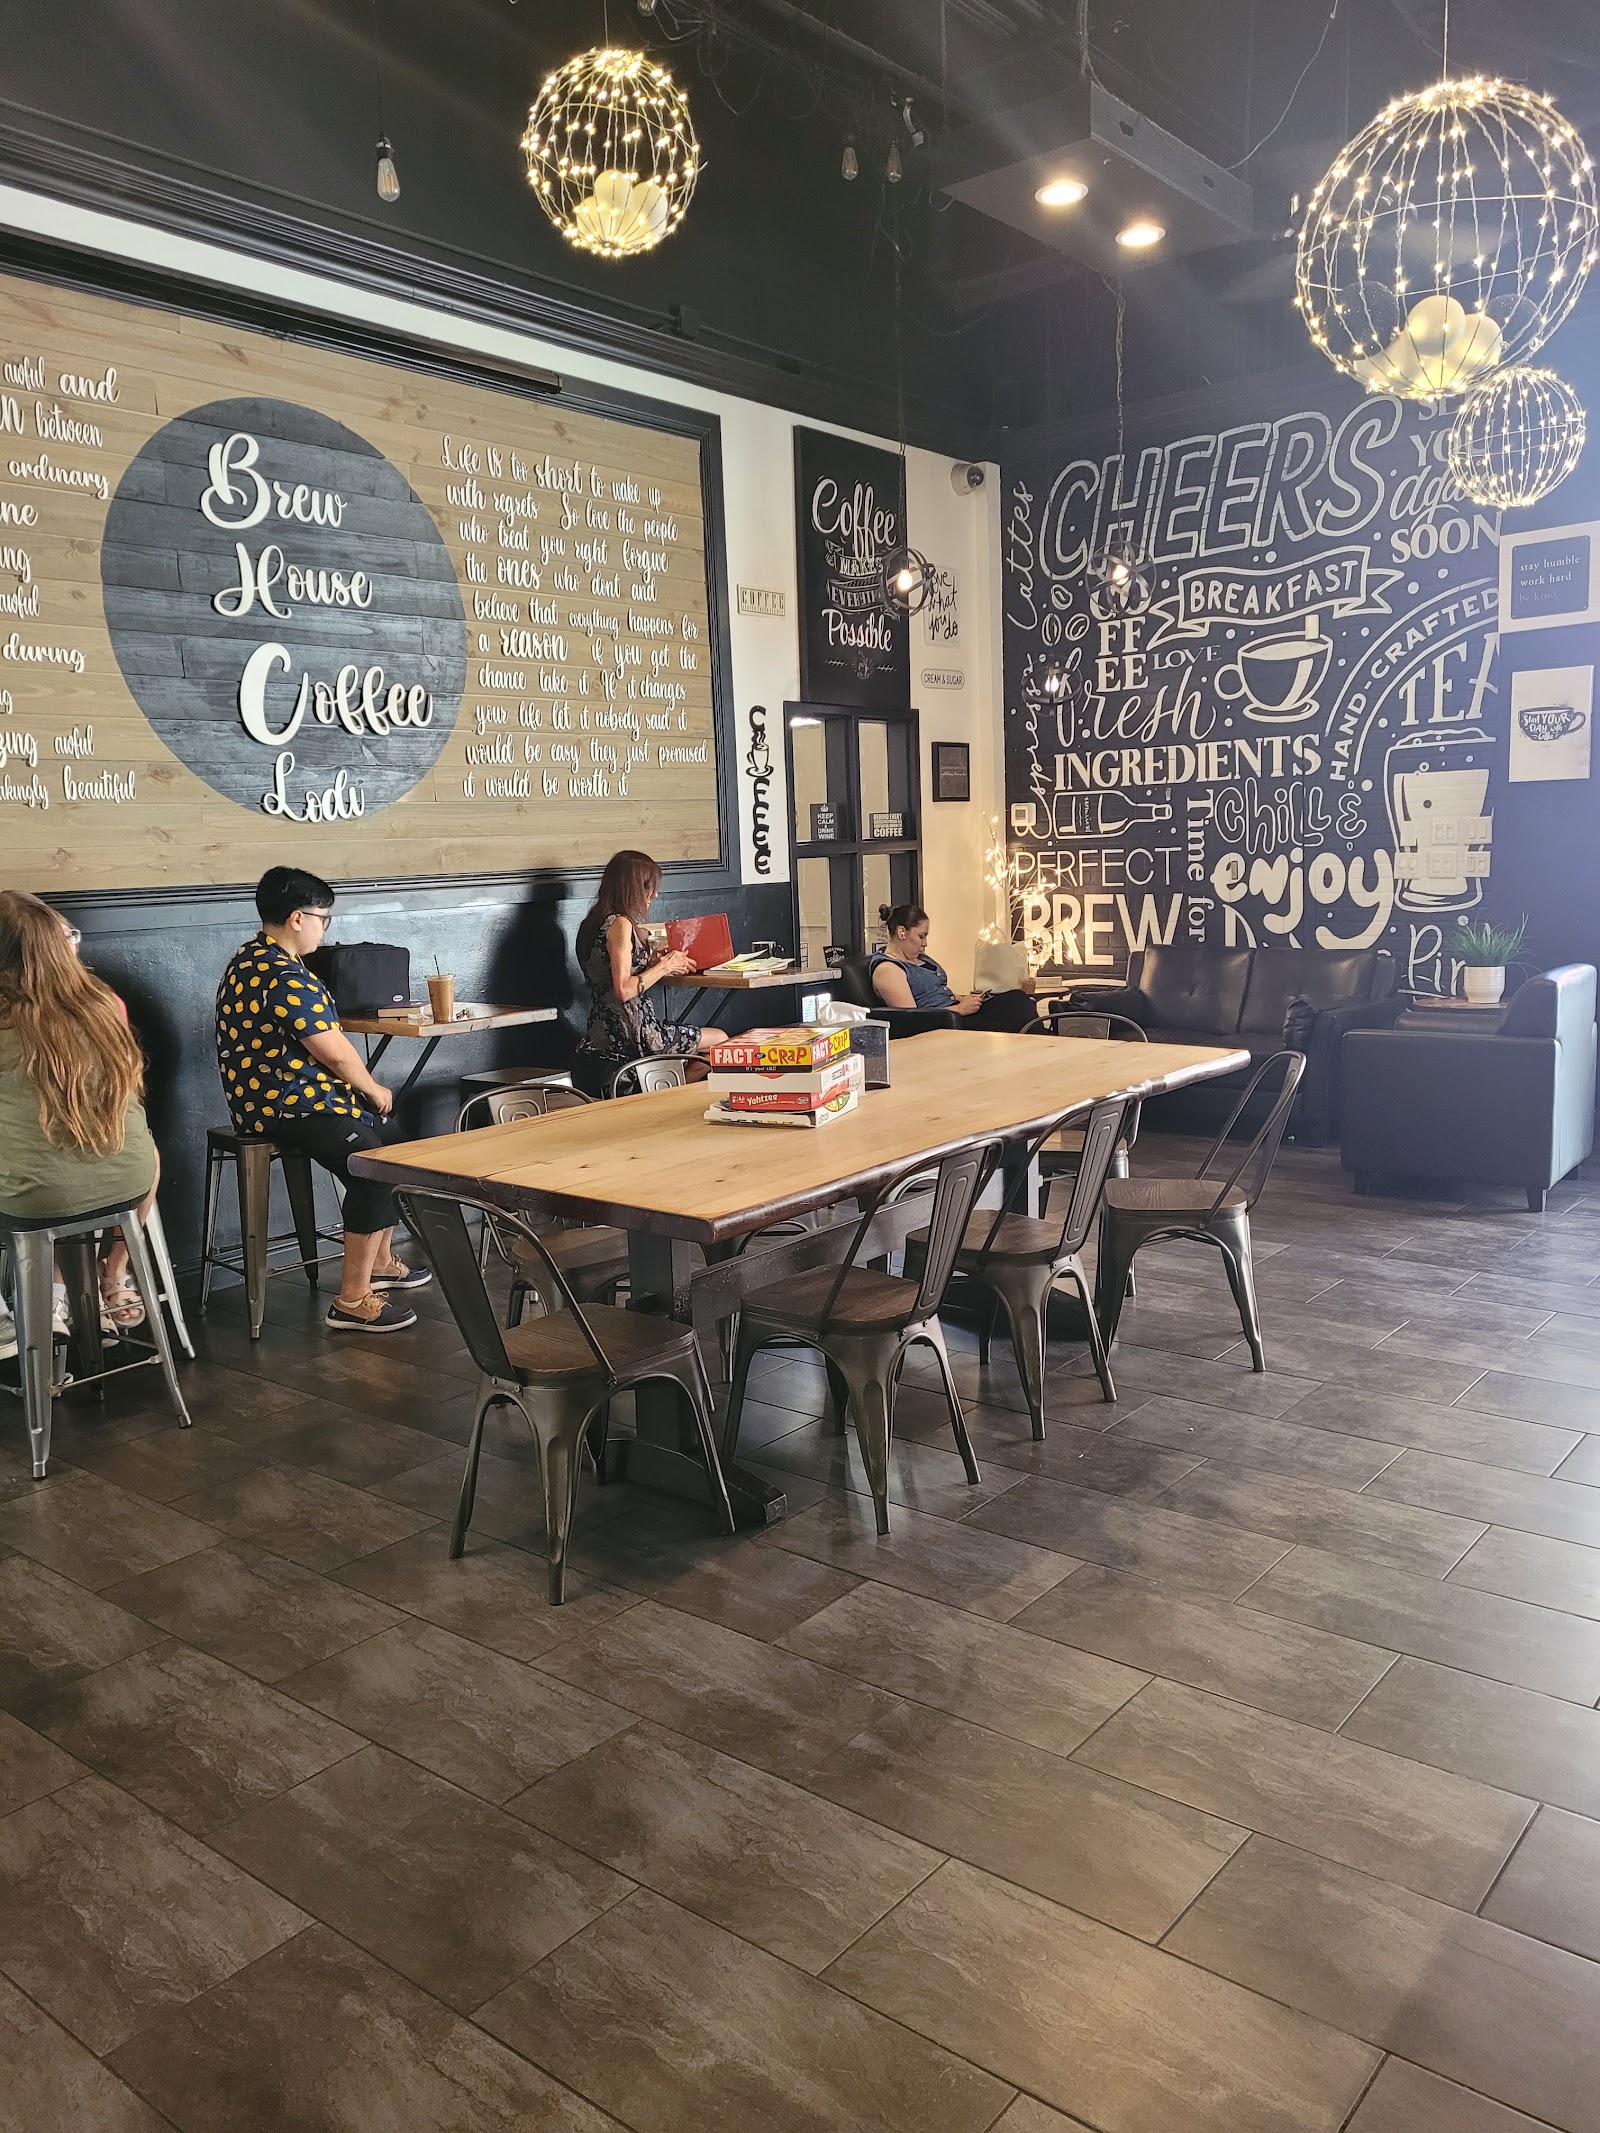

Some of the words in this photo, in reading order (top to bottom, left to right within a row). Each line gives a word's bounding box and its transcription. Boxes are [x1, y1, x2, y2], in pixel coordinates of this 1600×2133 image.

[4, 356, 46, 391] awful
[59, 367, 120, 402] and
[35, 400, 103, 447] between
[1410, 419, 1497, 467] YOU
[8, 453, 109, 500] ordinary
[200, 433, 347, 529] Brew
[441, 435, 480, 474] Life
[511, 451, 528, 481] too
[535, 455, 583, 494] short
[590, 466, 606, 498] to
[611, 475, 640, 503] wake
[648, 486, 662, 514] up
[1039, 396, 1402, 580] CHEERS
[446, 478, 487, 510] with
[492, 491, 539, 527] regrets
[586, 499, 610, 530] love
[617, 508, 635, 534] the
[643, 515, 679, 546] people
[811, 477, 896, 562] Coffee
[1389, 465, 1504, 532] aga
[459, 515, 489, 543] who
[498, 519, 530, 551] treat
[541, 534, 566, 565] you
[575, 537, 608, 573] right
[622, 538, 669, 583] forgive
[1391, 511, 1502, 563] SOON
[213, 543, 373, 620] House
[465, 551, 488, 583] the
[553, 565, 581, 591] who
[591, 570, 621, 598] dont
[631, 577, 657, 602] and
[840, 556, 883, 577] MAKES
[1190, 560, 1358, 614] BREAKFAST
[1520, 562, 1539, 572] stay
[1543, 555, 1580, 568] humble
[1520, 575, 1545, 587] work
[1549, 571, 1571, 583] hard
[473, 589, 520, 622] believe
[529, 597, 558, 625] that
[569, 608, 620, 640] everything
[628, 607, 675, 639] happens
[681, 614, 698, 641] for
[741, 590, 784, 609] COFFEE
[831, 585, 896, 607] EVERYTH
[822, 608, 893, 651] Possible
[929, 613, 947, 640] you
[943, 611, 958, 639] do
[3, 632, 86, 673] during
[478, 633, 491, 652] a
[499, 627, 569, 661] reason
[614, 643, 642, 679] you
[651, 643, 670, 678] get
[679, 645, 698, 670] the
[1152, 644, 1223, 670] LOVE
[239, 642, 434, 746] Coffee
[479, 661, 526, 690] chance
[538, 666, 569, 693] take
[578, 670, 590, 695] it
[627, 674, 638, 699] it
[640, 673, 687, 711] changes
[923, 673, 940, 684] CREAM
[942, 674, 946, 685] &
[946, 675, 962, 685] SUGAR
[1399, 631, 1500, 727] TEA
[54, 725, 94, 759] awful
[476, 704, 508, 735] your
[519, 700, 542, 730] life
[552, 700, 571, 730] let
[580, 704, 590, 730] it
[594, 703, 641, 741] nobody
[645, 706, 671, 730] said
[678, 707, 688, 731] it
[1541, 712, 1571, 725] YOUR
[465, 733, 514, 765] would
[524, 735, 542, 763] be
[550, 743, 581, 774] easy
[589, 737, 618, 774] they
[624, 738, 651, 774] just
[657, 739, 709, 769] promised
[1054, 734, 1322, 791] INGREDIENTS
[63, 764, 137, 804] beautiful
[263, 751, 366, 823] Lodi
[463, 771, 476, 798] it
[484, 768, 532, 798] would
[542, 768, 560, 798] be
[567, 767, 611, 797] worth
[618, 771, 629, 796] it
[873, 828, 903, 838] COFFEE
[1187, 789, 1215, 882] Time
[1014, 846, 1183, 888] PERFECT
[1187, 896, 1215, 943] for
[1209, 847, 1395, 950] enjoy
[1022, 892, 1184, 966] BREW
[714, 1049, 754, 1064] FACT
[812, 1040, 829, 1062] FACT
[747, 1094, 778, 1107] Yahtzee
